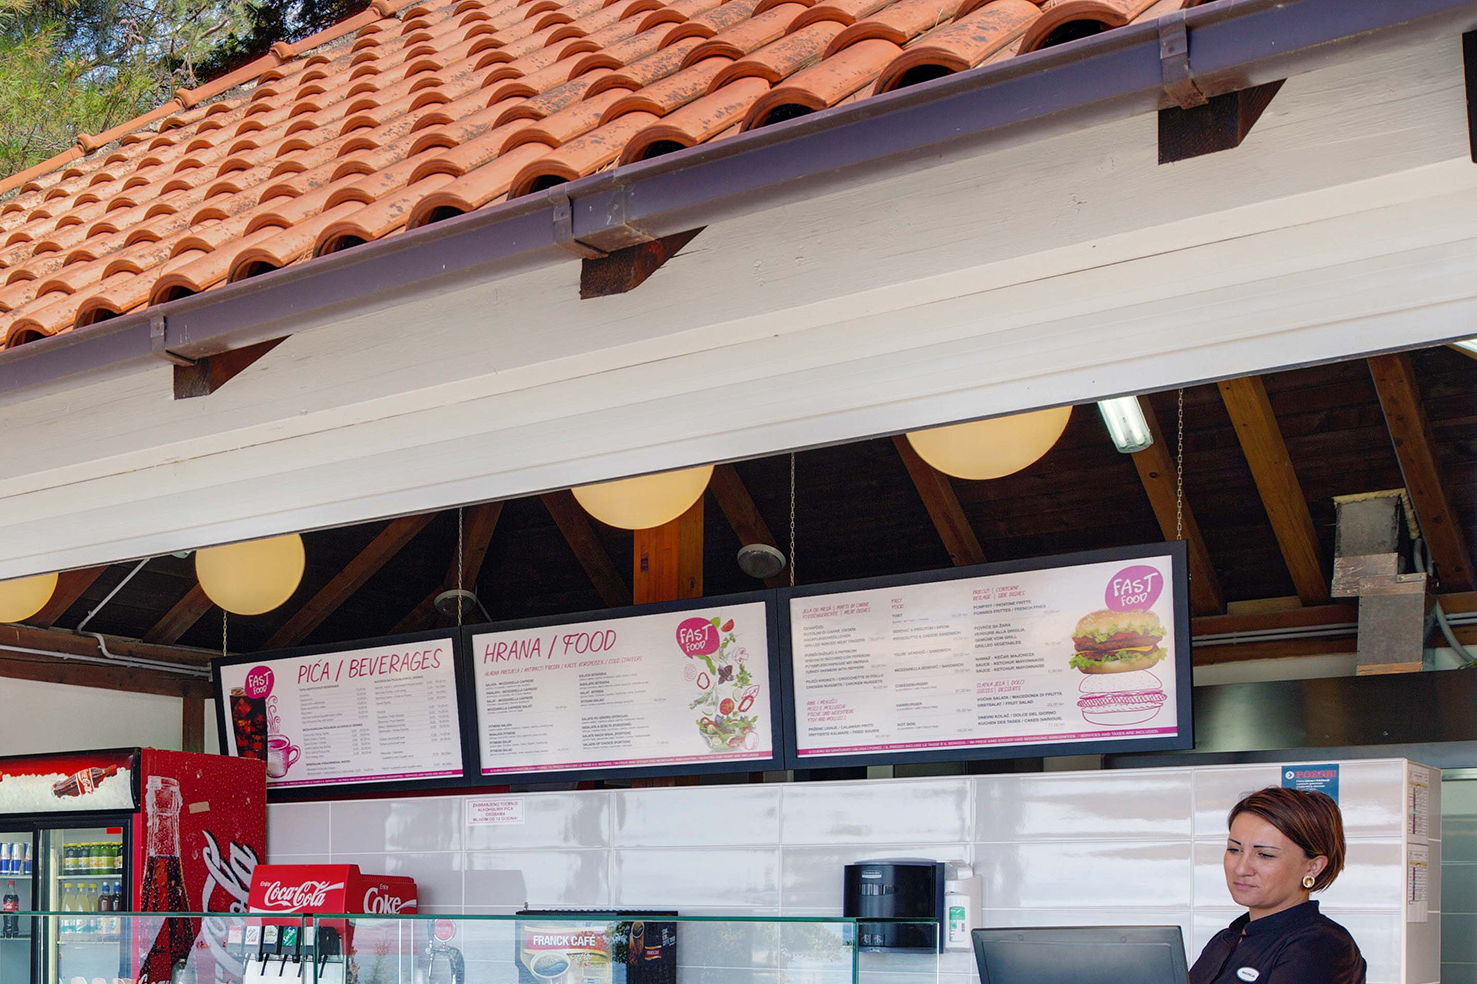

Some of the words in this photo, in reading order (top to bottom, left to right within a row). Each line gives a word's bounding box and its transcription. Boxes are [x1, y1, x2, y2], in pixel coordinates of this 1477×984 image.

[1113, 572, 1158, 596] FAST
[1121, 592, 1147, 607] FOOD
[679, 623, 710, 644] FAST
[482, 637, 541, 664] HRANA
[562, 629, 617, 656] FOOD
[685, 639, 706, 652] FOOD
[296, 659, 331, 685] PIĆA
[348, 648, 444, 680] BEVERAGES
[248, 671, 273, 688] FAST
[252, 684, 268, 696] FOOD
[1296, 770, 1337, 778] POZOR!
[264, 881, 344, 907] Coca-Cola
[363, 887, 410, 914] Coke
[533, 935, 569, 946] FRANCK
[571, 933, 596, 946] CAFÉ
